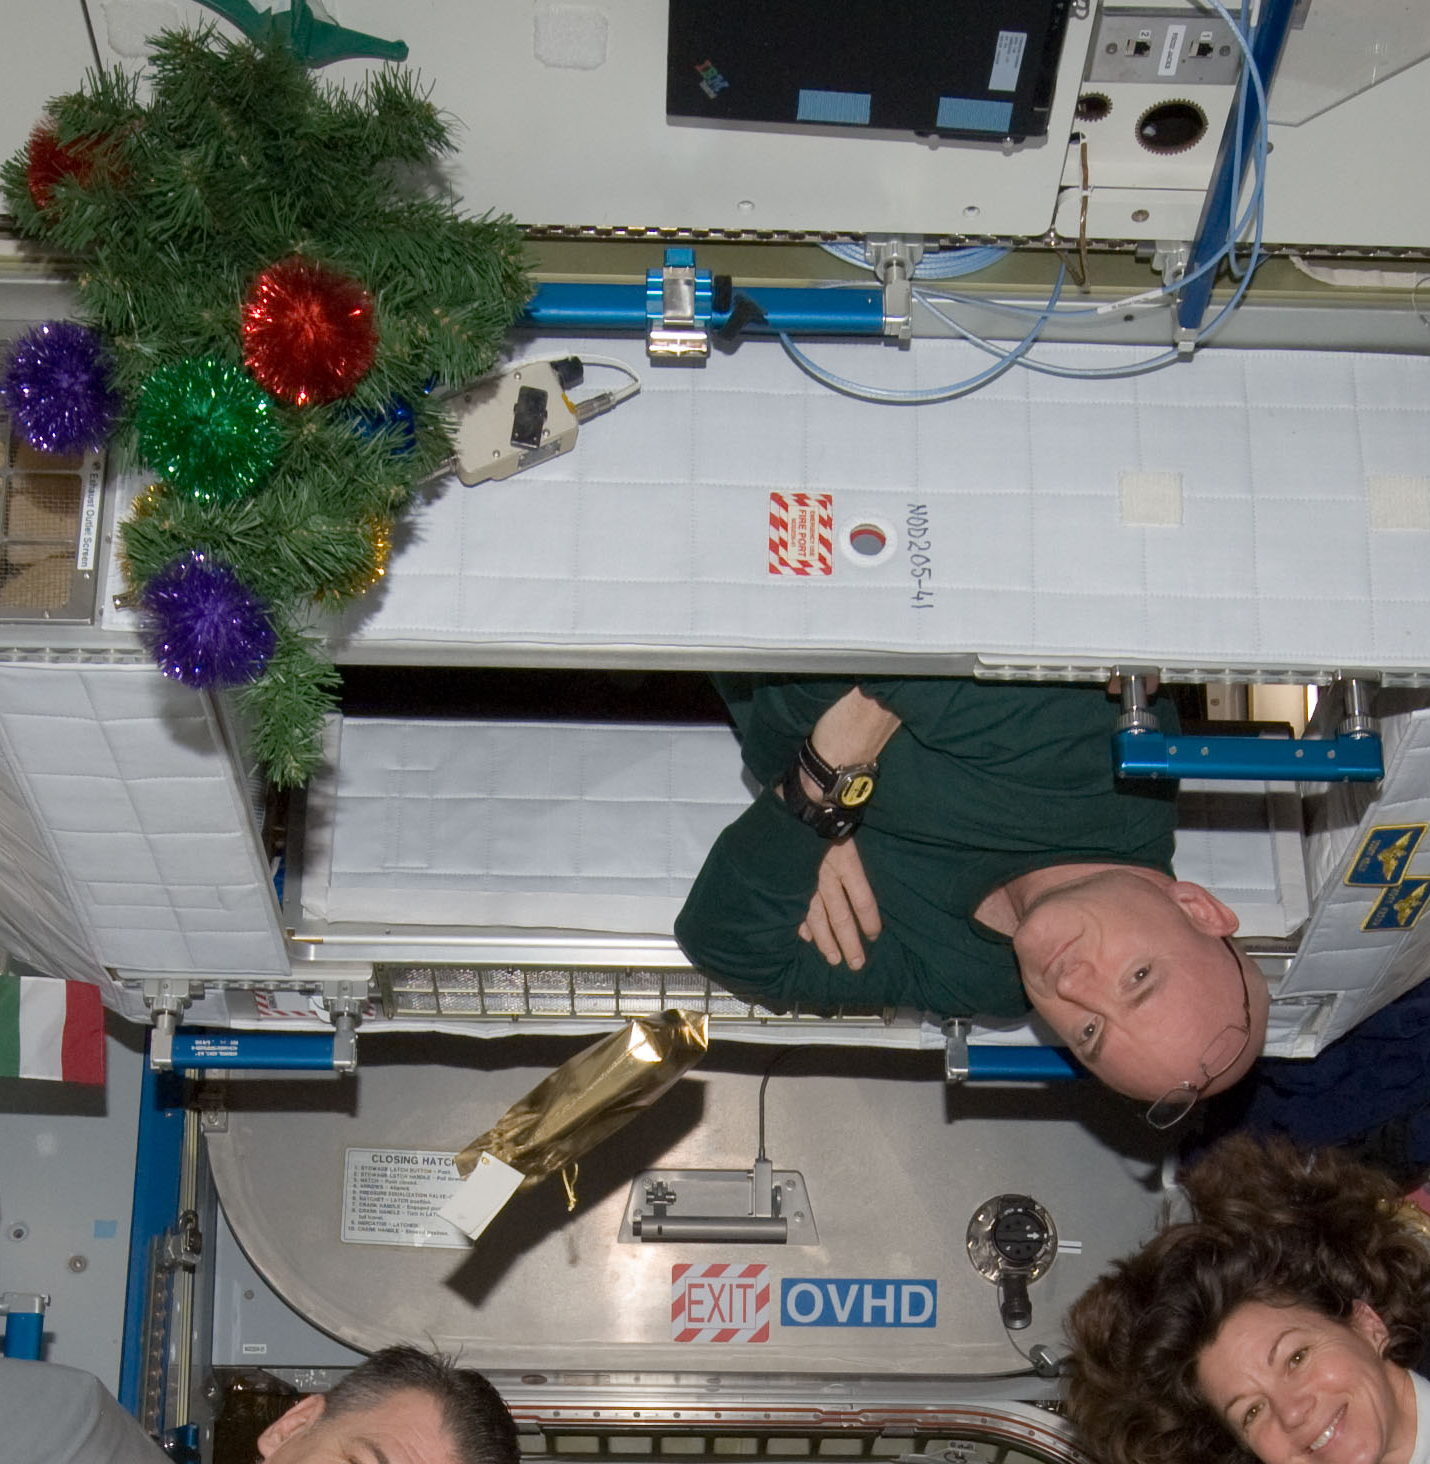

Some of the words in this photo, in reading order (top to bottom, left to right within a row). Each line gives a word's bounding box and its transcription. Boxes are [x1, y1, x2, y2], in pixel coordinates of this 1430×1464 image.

[89, 473, 102, 509] Exhaust
[86, 509, 98, 536] Outlet
[799, 509, 809, 531] FIRE
[82, 535, 95, 570] Screen
[798, 532, 808, 558] PORT
[372, 1155, 418, 1164] CLOSING
[687, 1283, 755, 1324] EXIT
[786, 1282, 934, 1324] OVHD
